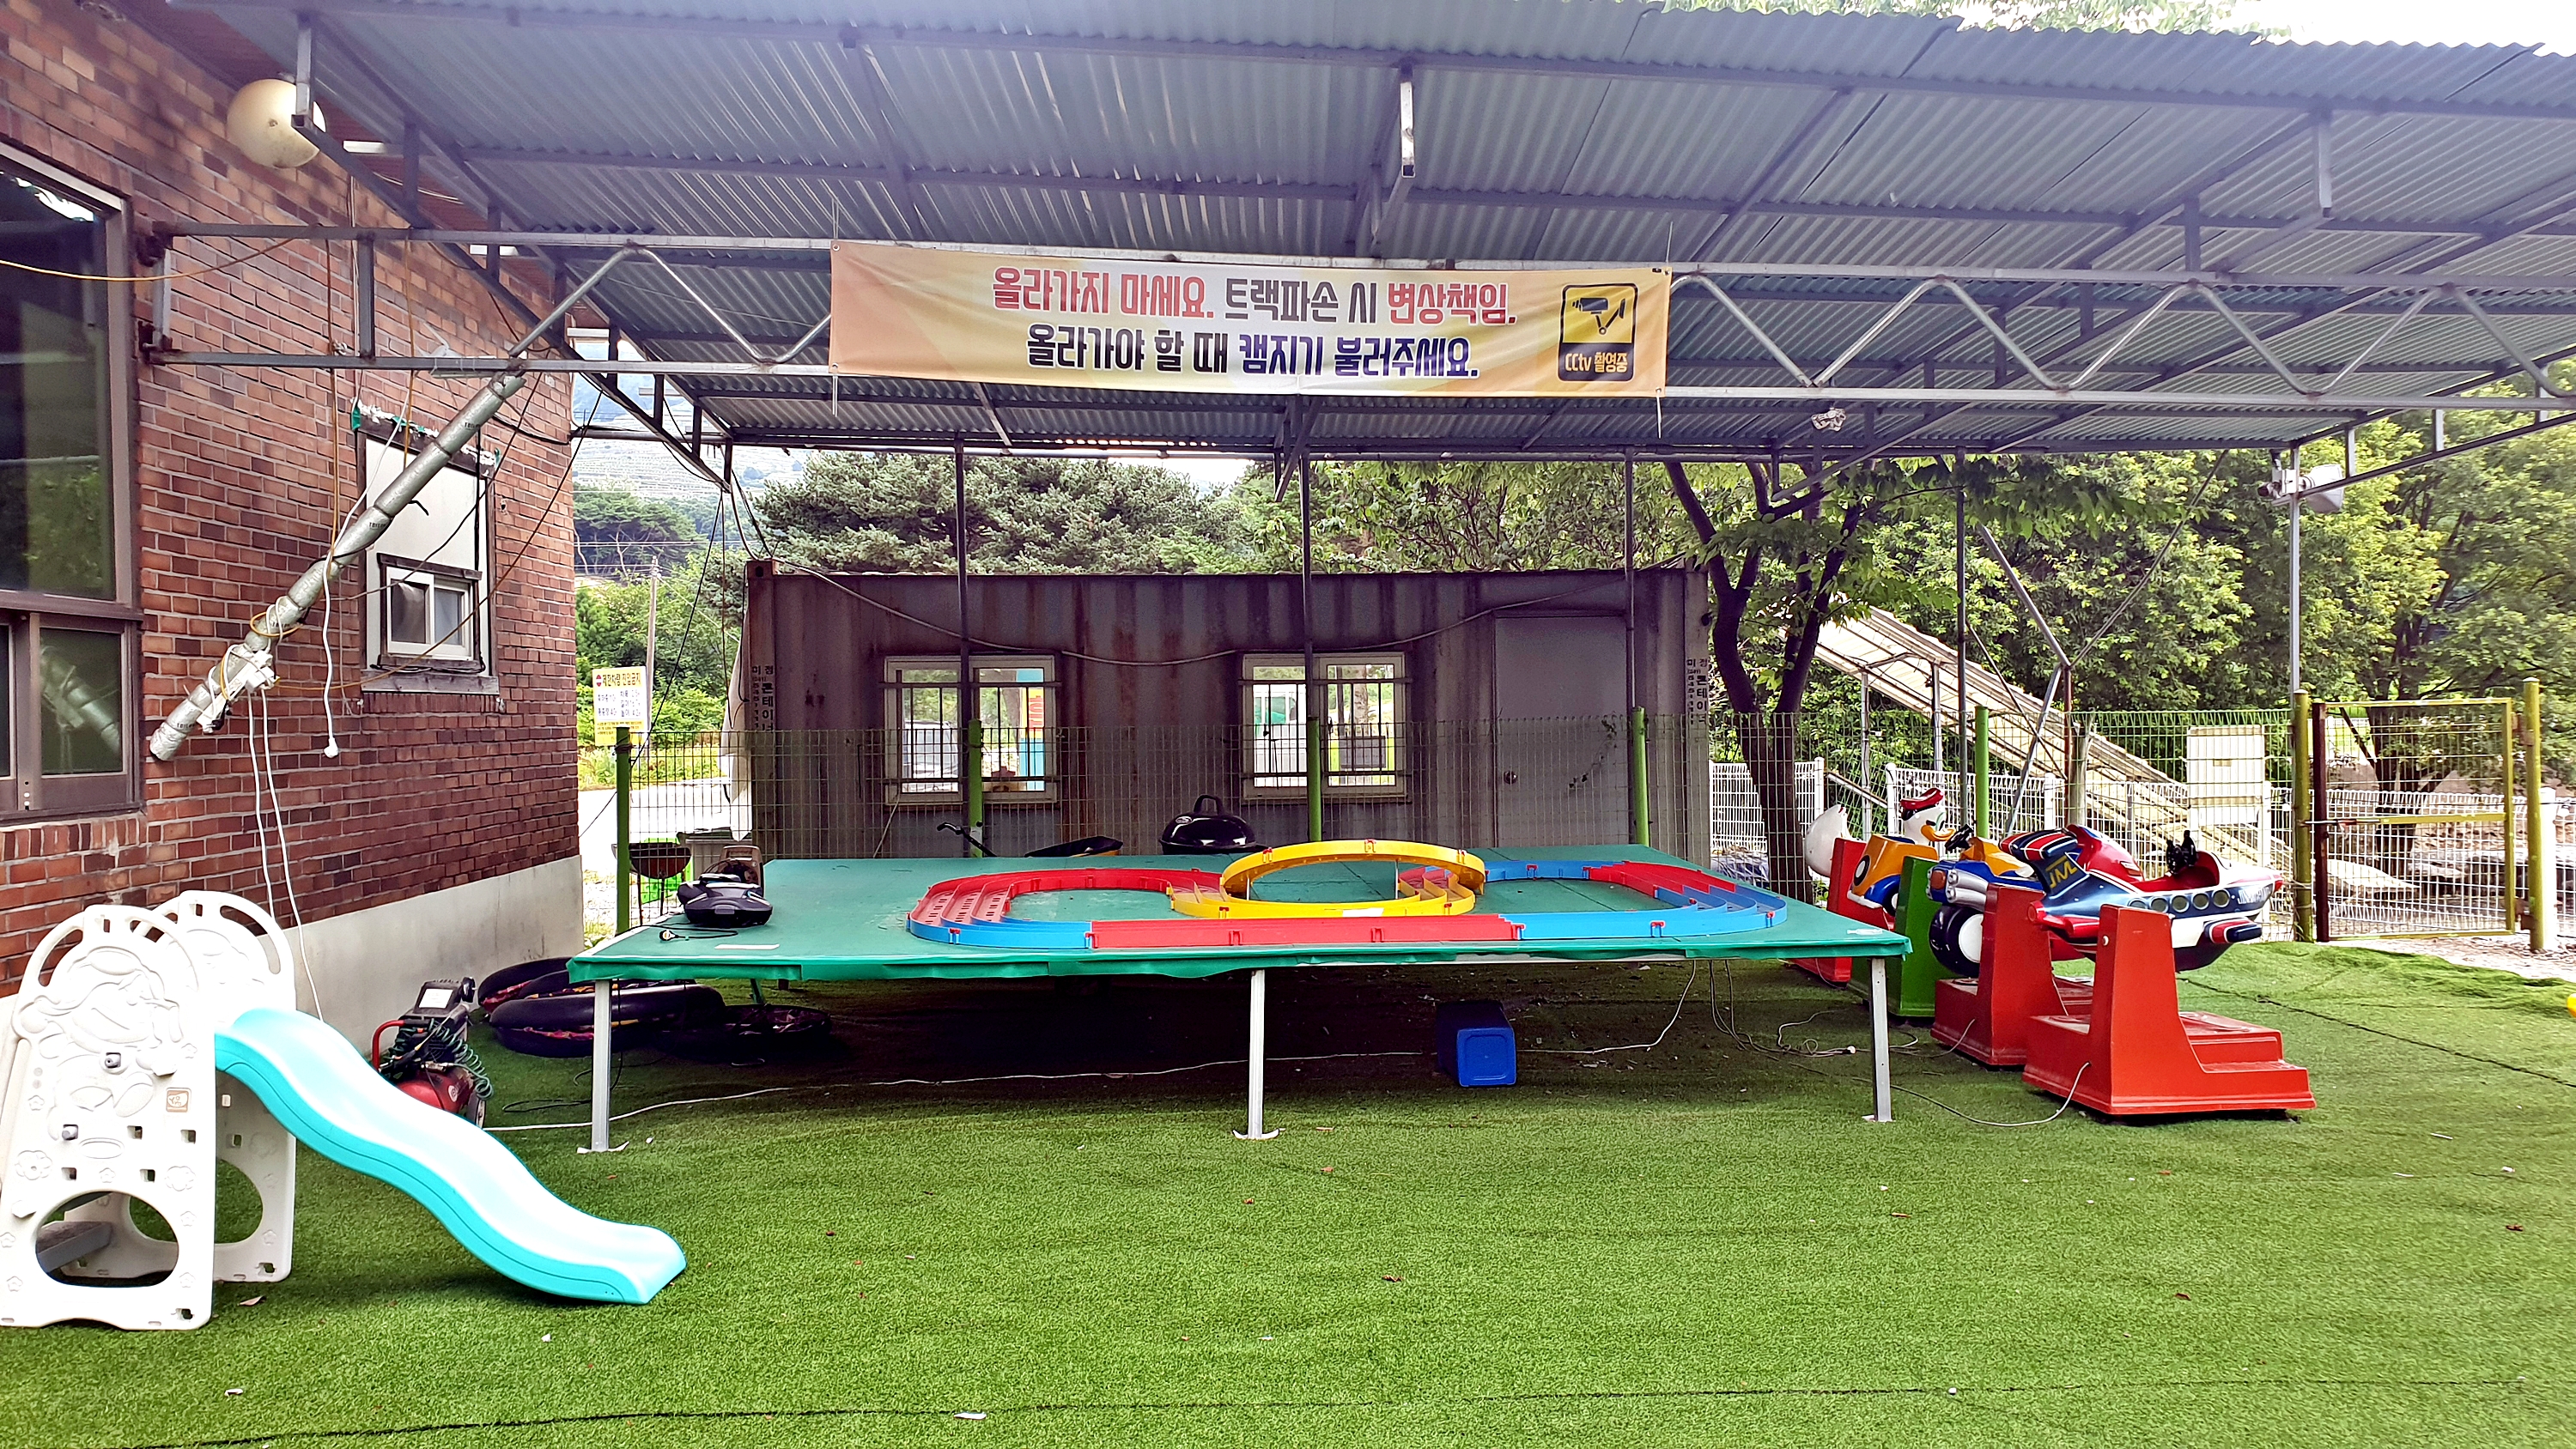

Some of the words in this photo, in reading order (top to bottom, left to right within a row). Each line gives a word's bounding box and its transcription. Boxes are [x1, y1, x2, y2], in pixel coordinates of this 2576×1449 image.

[993, 266, 1109, 314] 올라가지
[1121, 273, 1214, 318] 마세요.
[1225, 276, 1340, 323] 트랙파손
[1348, 282, 1376, 324] 시
[1388, 283, 1517, 325] 변상책임.
[1027, 324, 1145, 371] 올라가야
[1154, 330, 1183, 372] 할
[1194, 332, 1228, 373] 때
[1238, 334, 1323, 375] 캠지기
[1334, 336, 1479, 378] 불러주세요.
[1595, 352, 1628, 373] 촬영중
